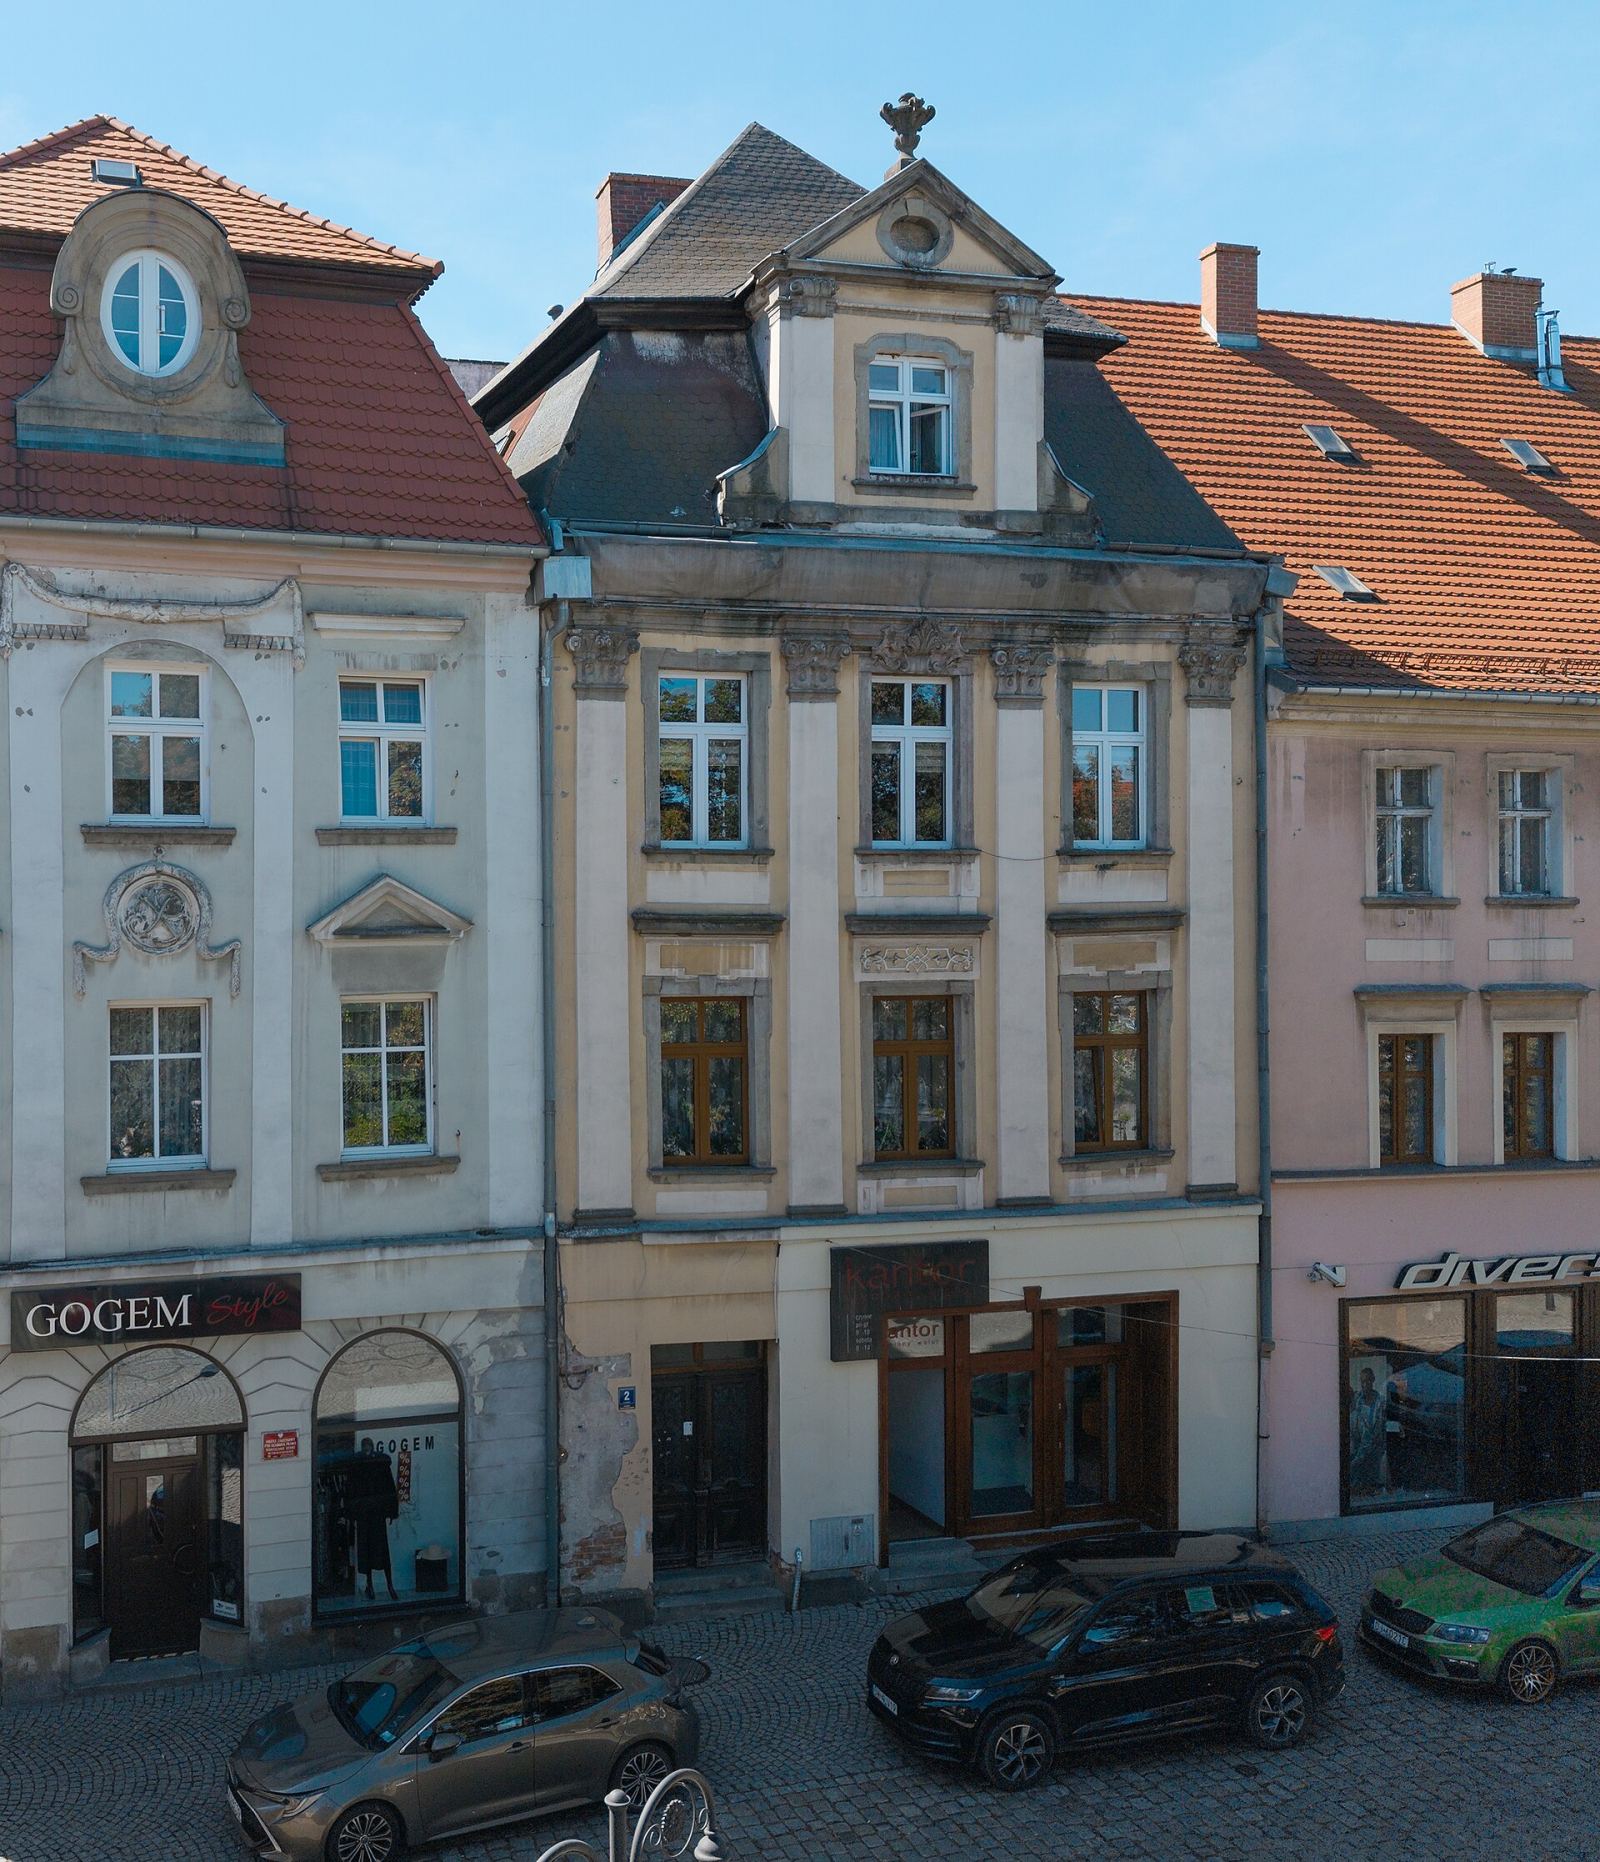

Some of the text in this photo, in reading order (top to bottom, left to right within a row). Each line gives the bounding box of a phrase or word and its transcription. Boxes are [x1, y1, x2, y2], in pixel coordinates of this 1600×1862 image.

[845, 1256, 976, 1290] kantor
[1395, 1252, 1600, 1289] diver
[26, 1282, 289, 1337] GOGEM Style
[887, 1321, 939, 1339] antor
[623, 1391, 630, 1401] 2
[376, 1436, 435, 1454] GOGEM
